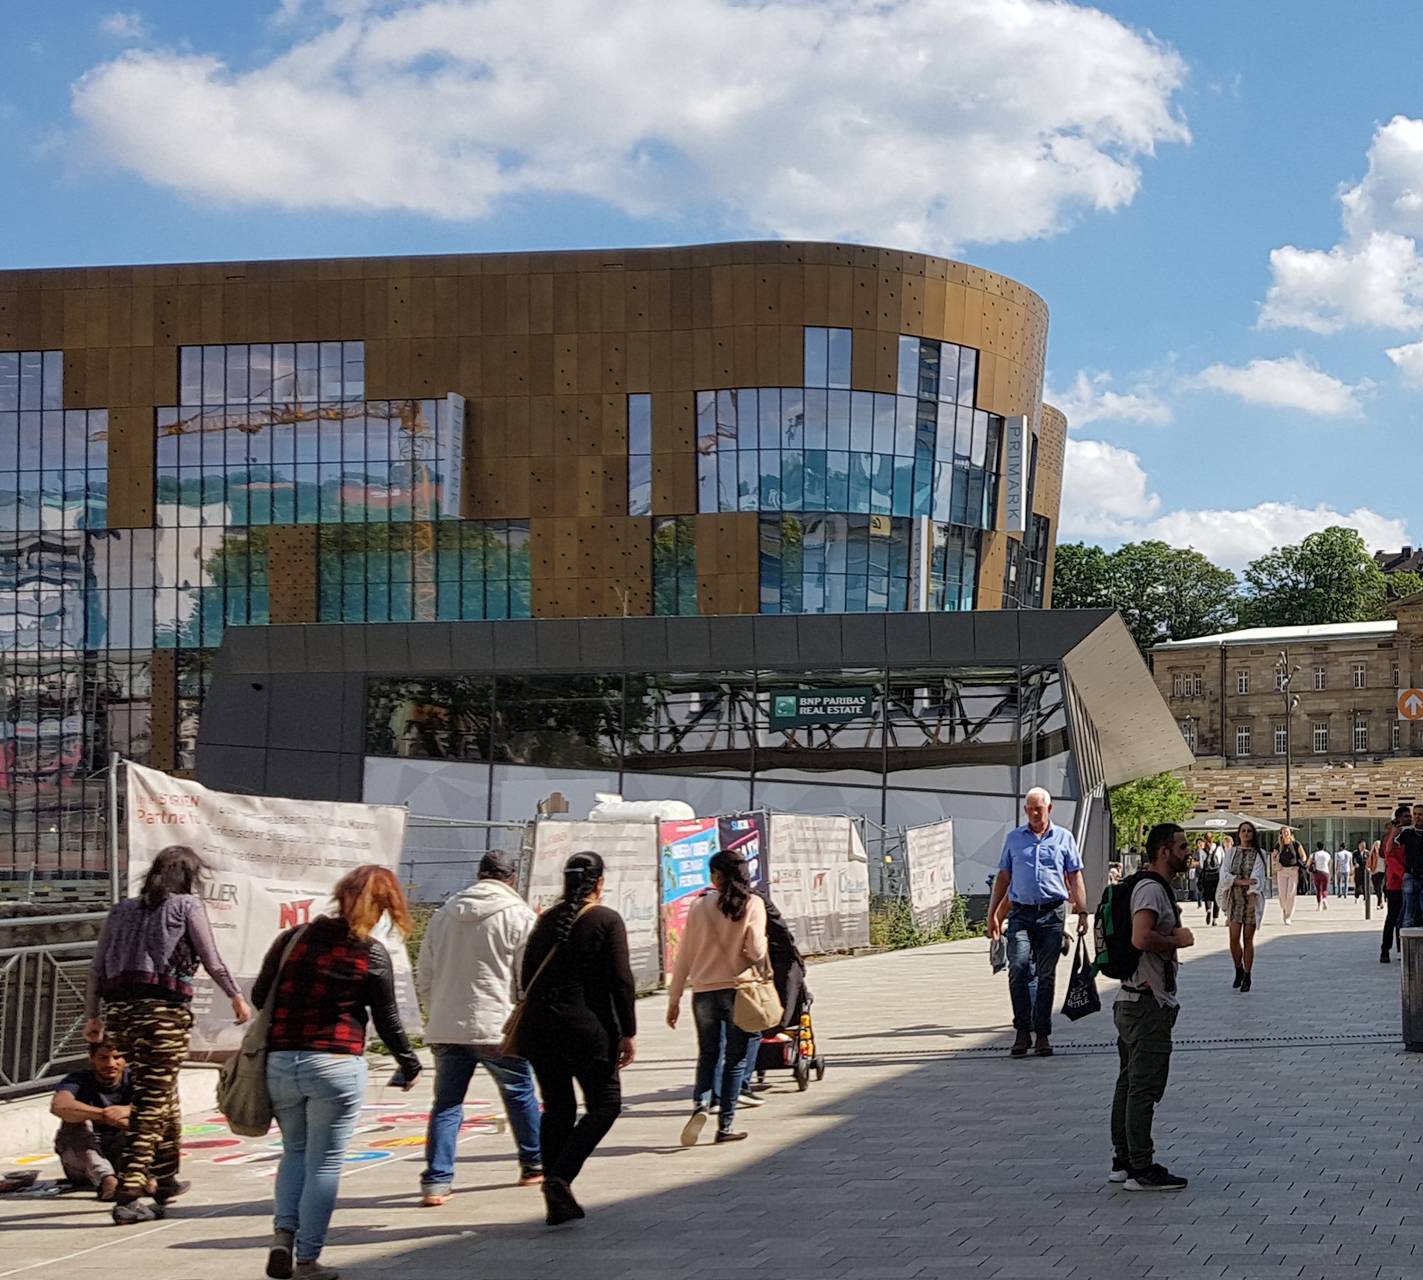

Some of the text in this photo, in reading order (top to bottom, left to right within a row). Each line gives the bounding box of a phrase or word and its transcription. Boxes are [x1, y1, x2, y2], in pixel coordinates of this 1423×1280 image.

[1008, 426, 1021, 519] PRIMARK
[800, 696, 866, 706] BNP PARIBAS
[800, 705, 863, 715] REAL ESTATE
